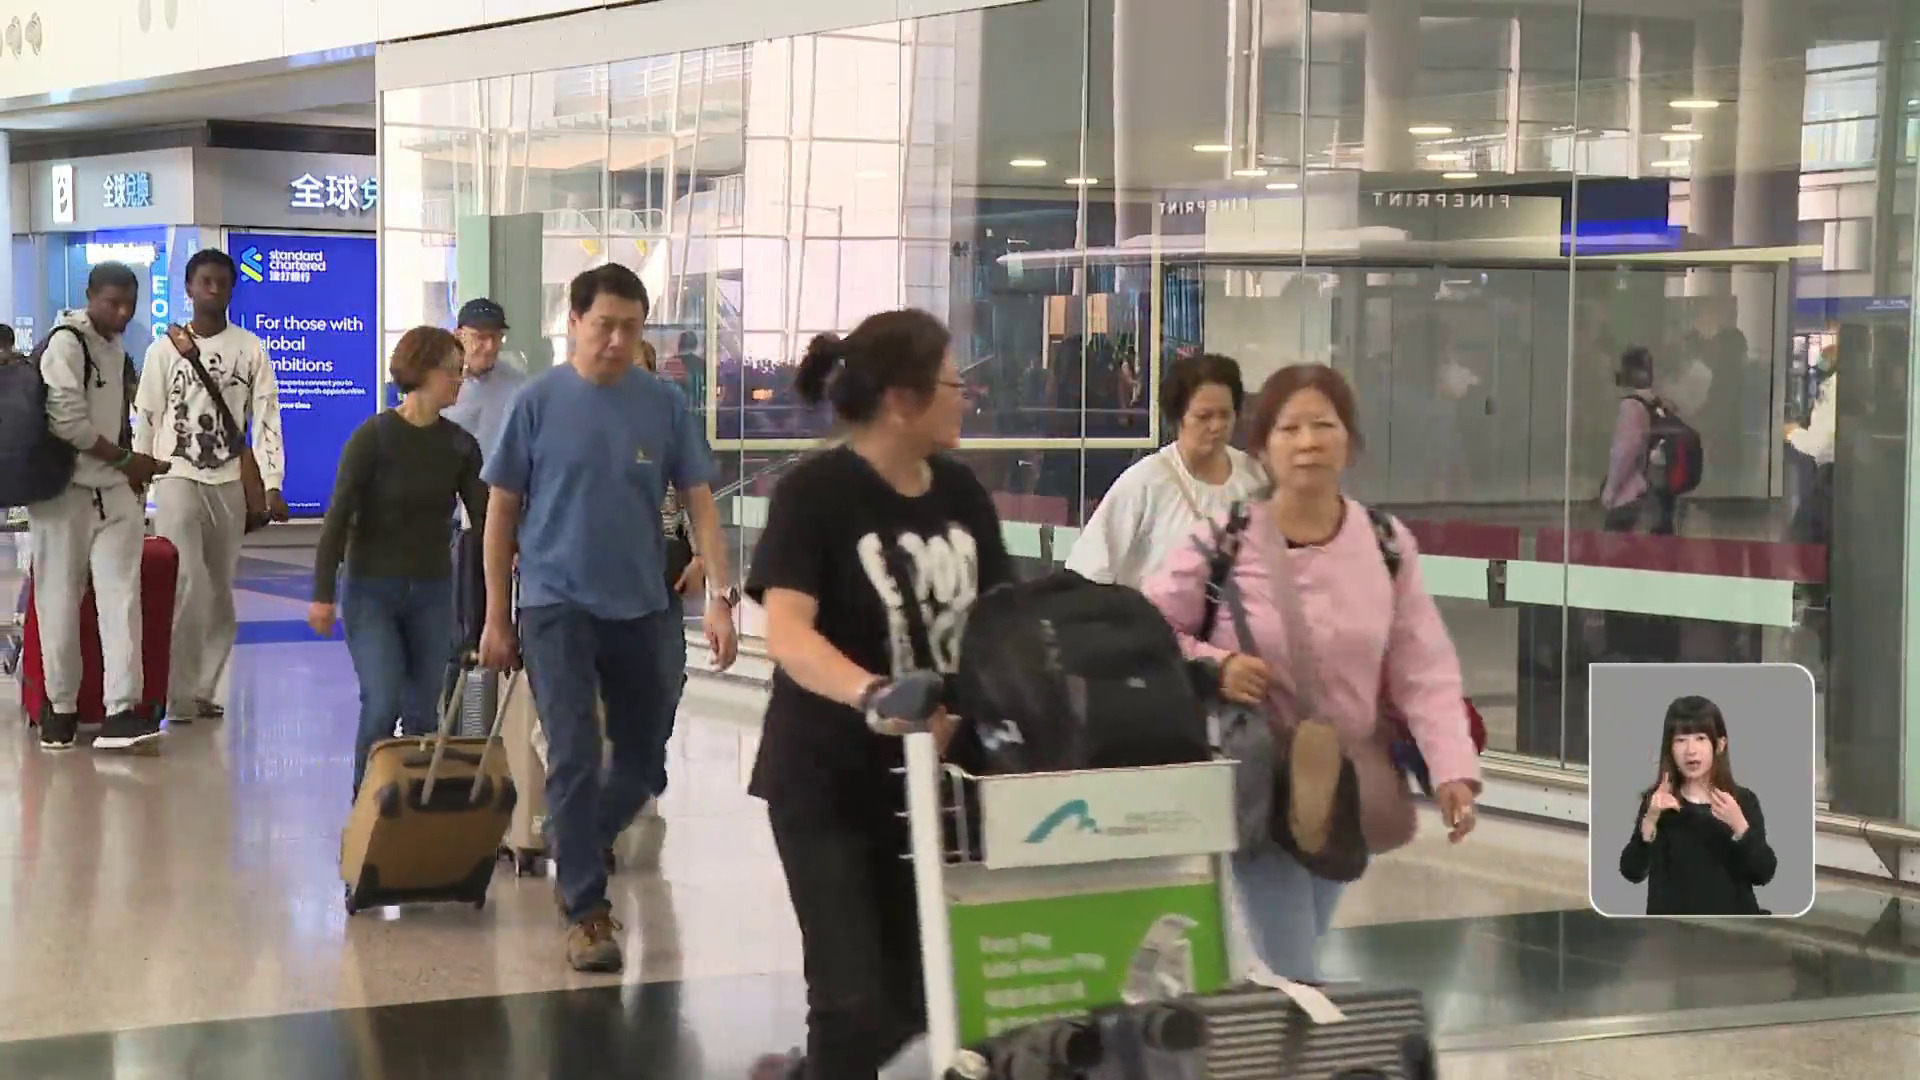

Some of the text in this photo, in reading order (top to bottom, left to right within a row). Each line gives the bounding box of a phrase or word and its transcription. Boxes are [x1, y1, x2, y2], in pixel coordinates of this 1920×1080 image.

[269, 249, 323, 262] standard
[269, 259, 326, 272] chartered
[256, 314, 363, 331] For those with
[270, 356, 333, 372] mbitions
